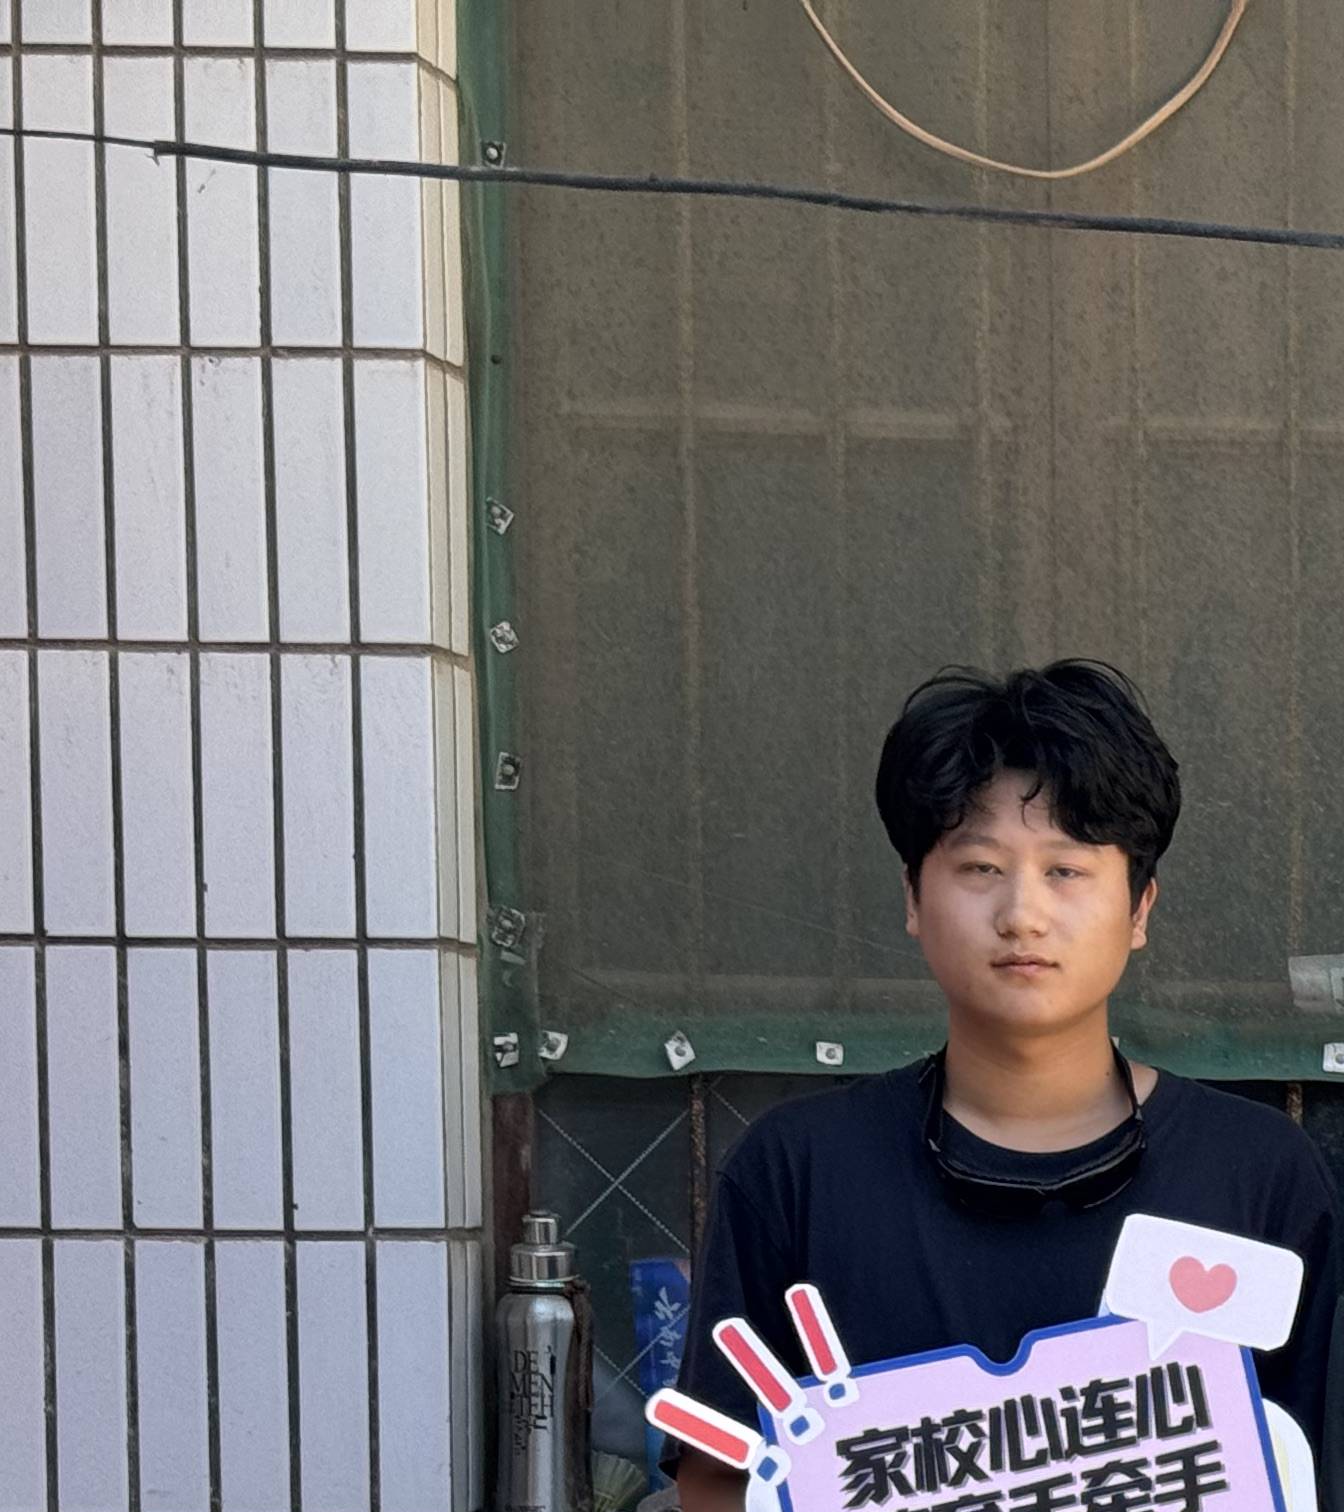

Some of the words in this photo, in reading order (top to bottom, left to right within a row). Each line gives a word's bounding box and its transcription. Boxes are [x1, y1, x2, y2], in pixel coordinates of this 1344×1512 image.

[836, 1362, 1212, 1509] 家校心连心
